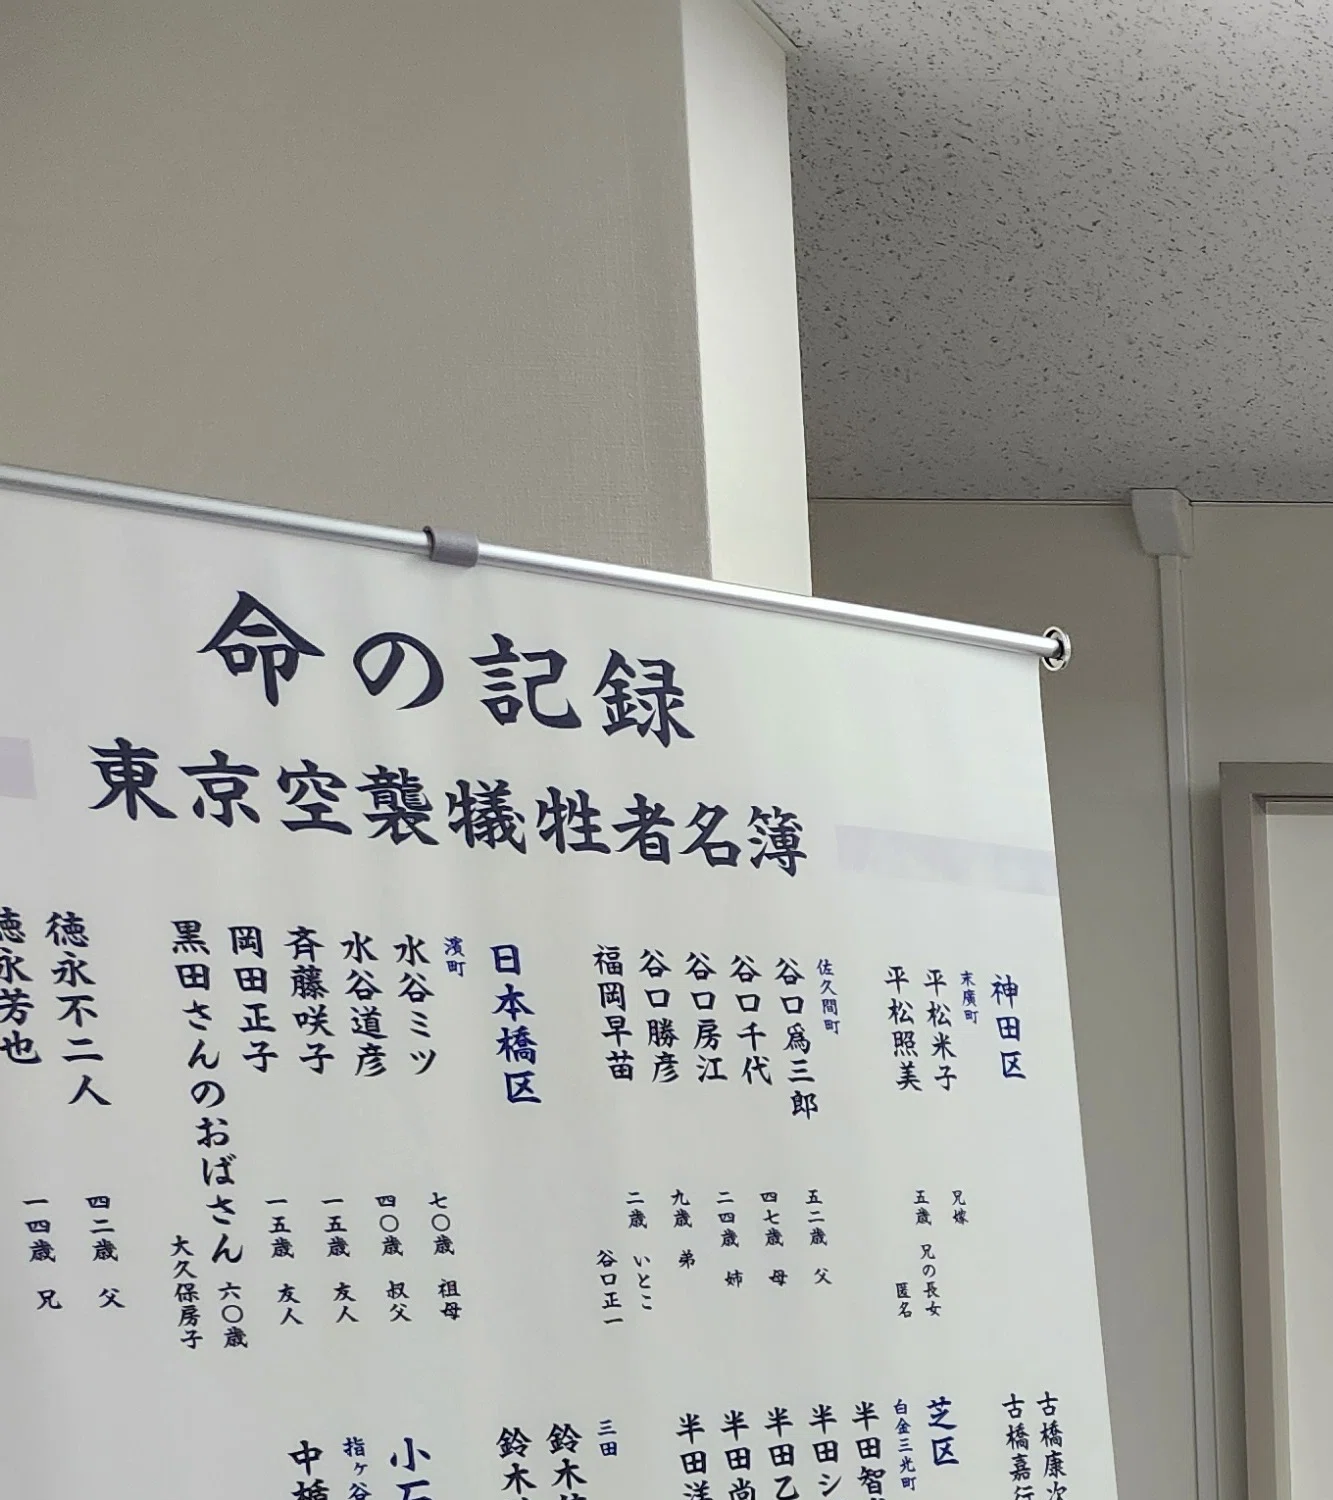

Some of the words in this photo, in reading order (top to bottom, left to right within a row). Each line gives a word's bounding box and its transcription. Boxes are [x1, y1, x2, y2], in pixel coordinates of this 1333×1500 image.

[197, 590, 697, 748] 命の記録
[88, 735, 808, 877] 東京空襲犠牲者名簿
[45, 911, 112, 1105] 徳永不二人
[227, 926, 279, 1073] 岡田正子
[284, 925, 335, 1074] 斉藤咲子
[340, 931, 388, 1077] 水谷道彦
[393, 934, 436, 1075] 水谷ミツ
[489, 944, 541, 1103] 日本橋区
[592, 944, 634, 1081] 福岡早苗
[639, 949, 680, 1083] 谷口勝彦
[685, 952, 728, 1083] 谷口房江
[729, 955, 772, 1085] 谷口千代
[817, 959, 840, 1035] 佐久間町
[884, 966, 922, 1091] 平松照美
[923, 969, 957, 1091] 平松米子
[990, 974, 1026, 1079] 神田区
[171, 920, 243, 1263] 黒田さんのおばさん
[85, 1196, 118, 1262] 四二歳
[265, 1199, 294, 1259] 一五歳
[321, 1199, 350, 1257] 一五歳
[760, 1192, 784, 1247] 四七歳
[805, 1189, 827, 1246] 五二歳
[914, 1190, 932, 1226] 五歳
[170, 1235, 203, 1349] 大久保房子
[277, 1283, 304, 1325] 友人
[333, 1282, 359, 1323] 友人
[386, 1280, 412, 1322] 叔父
[438, 1279, 462, 1320] 祖母
[596, 1249, 623, 1324] 谷口正一
[896, 1282, 912, 1318] 匿名
[920, 1244, 941, 1316] 兄の長女
[597, 1419, 617, 1456] 三田
[893, 1399, 916, 1491] 白金三光町
[926, 1396, 959, 1466] 芝区
